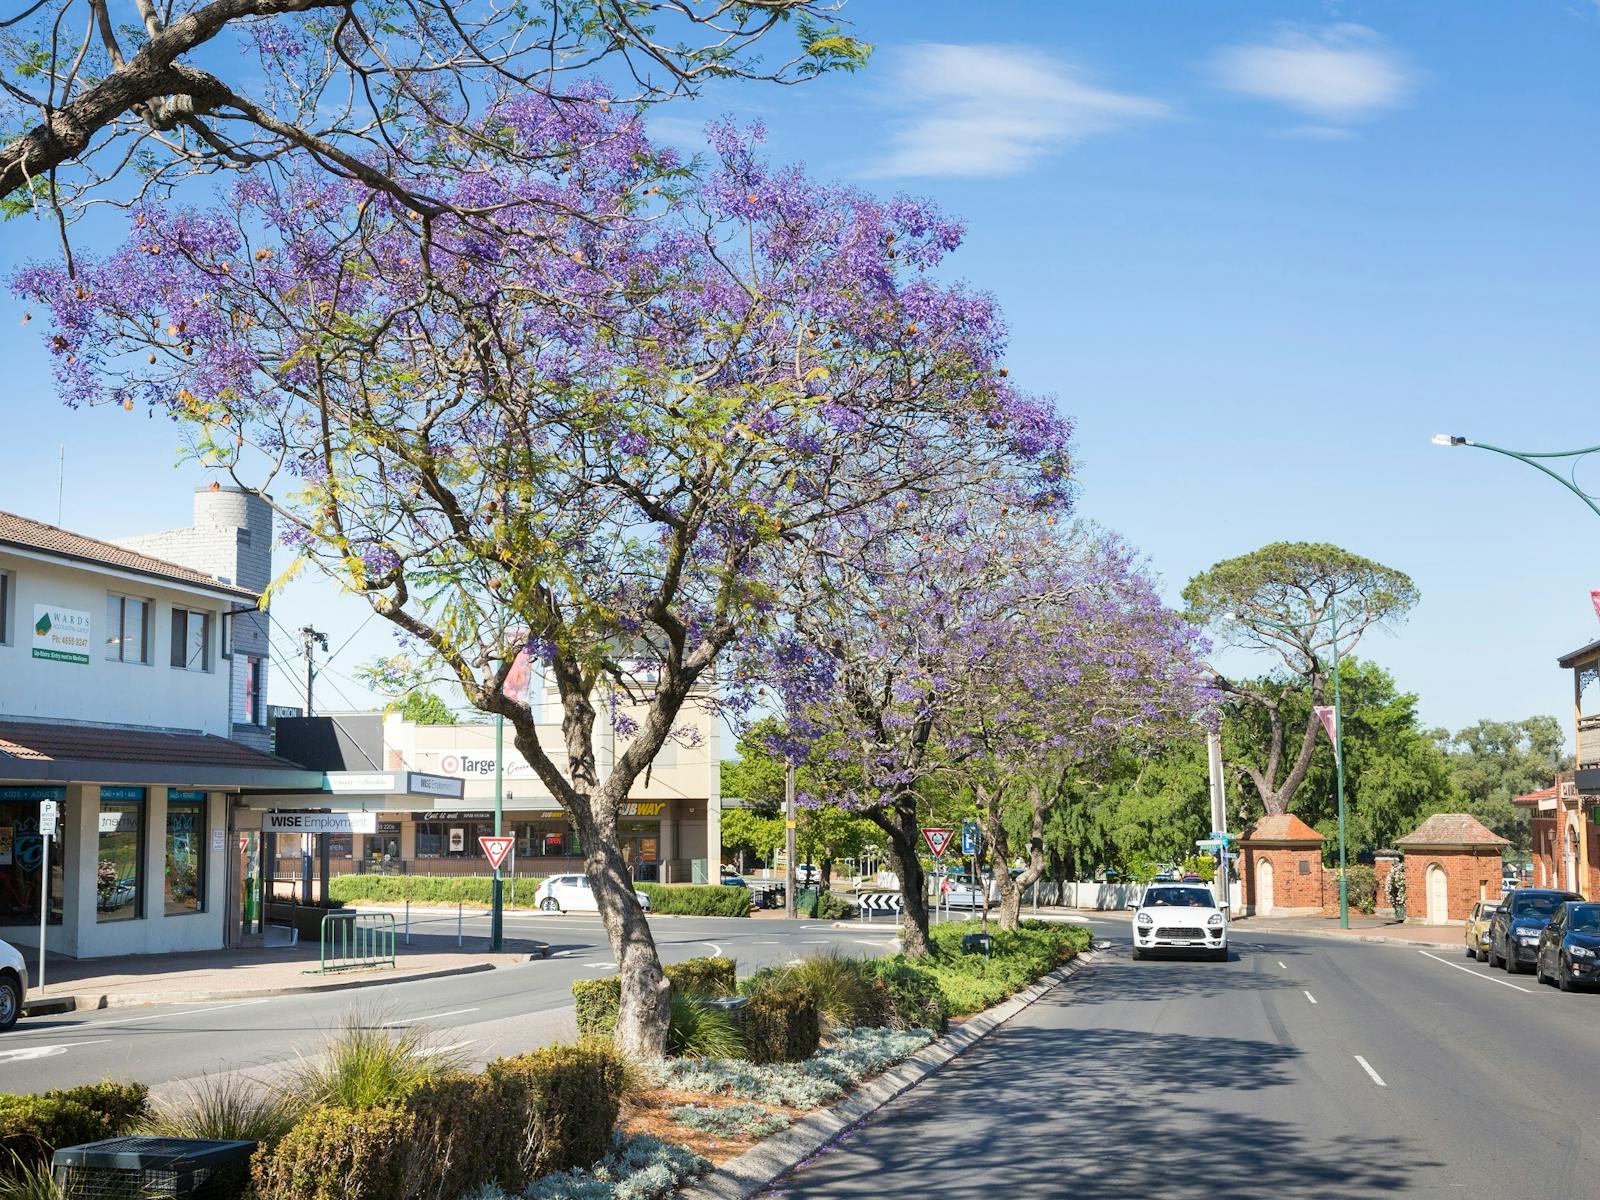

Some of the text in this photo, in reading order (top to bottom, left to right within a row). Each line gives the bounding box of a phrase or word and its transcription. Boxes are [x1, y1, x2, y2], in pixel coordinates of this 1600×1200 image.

[461, 756, 503, 774] Targe
[271, 816, 367, 829] WISE Employment
